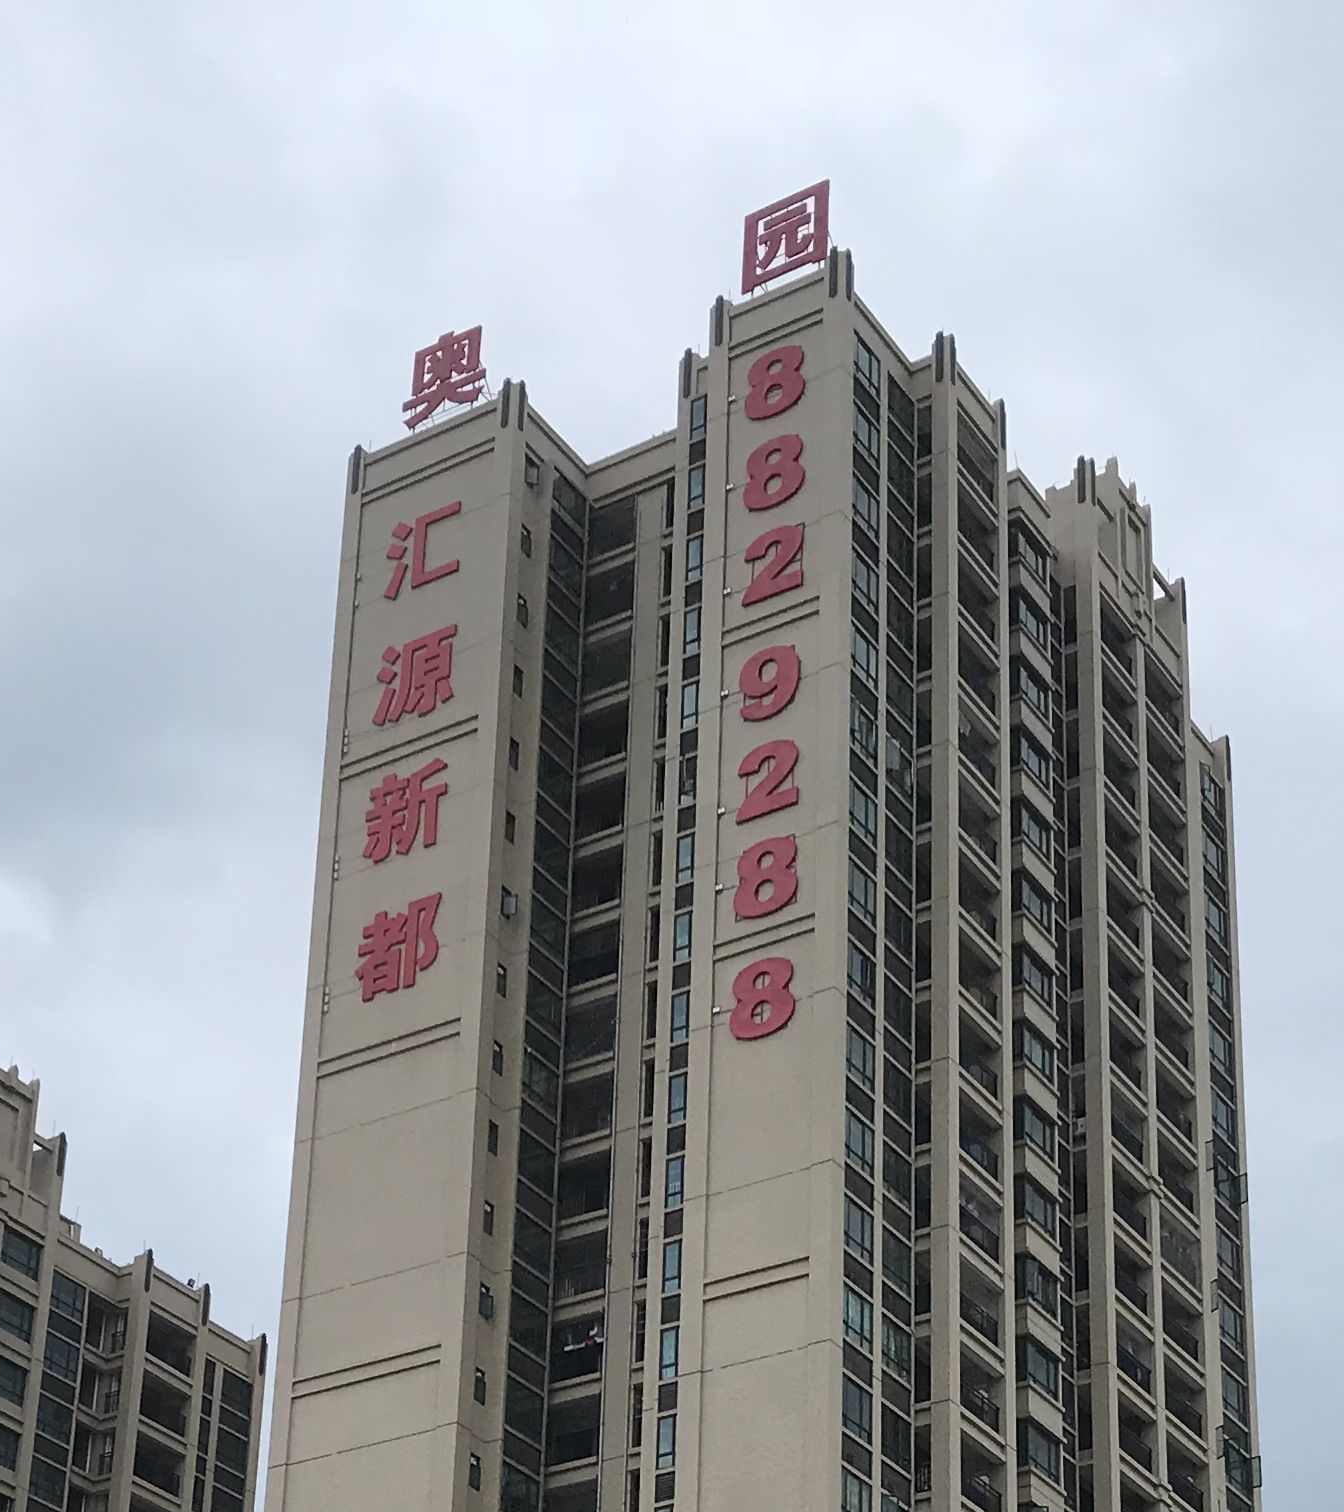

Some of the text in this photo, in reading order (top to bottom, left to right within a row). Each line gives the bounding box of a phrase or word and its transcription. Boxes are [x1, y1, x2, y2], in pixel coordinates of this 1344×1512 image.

[402, 325, 487, 430] 奥
[742, 180, 831, 295] 园
[355, 501, 462, 1001] 汇源新都
[729, 344, 806, 1041] 8829288
